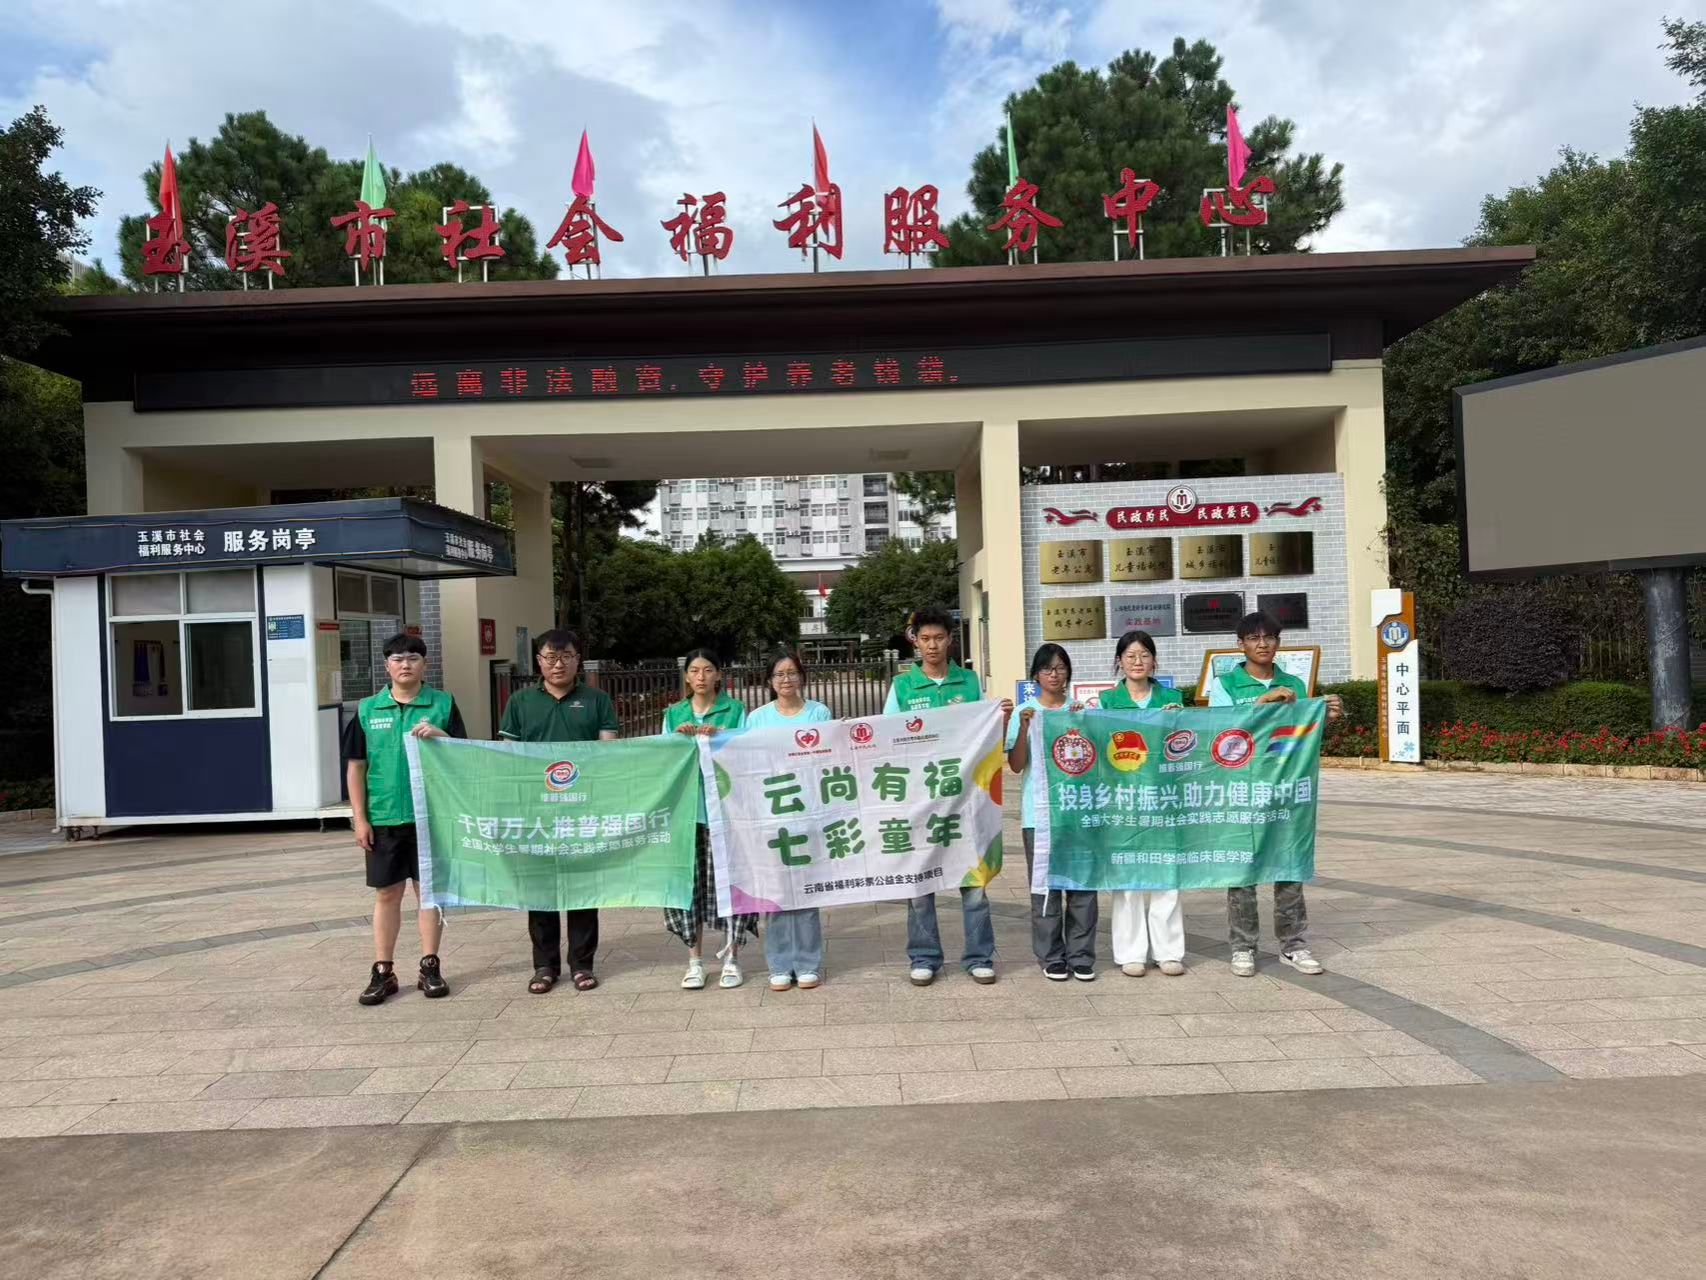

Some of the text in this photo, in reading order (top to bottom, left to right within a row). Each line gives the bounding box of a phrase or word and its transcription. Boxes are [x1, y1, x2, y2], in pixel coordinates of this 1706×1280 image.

[141, 168, 1276, 276] 玉溪市社会福利服务中心
[1116, 509, 1170, 523] 民政为民
[1197, 505, 1251, 520] 民政爱民
[137, 529, 205, 543] 玉溪市社会
[223, 528, 316, 553] 服务岗亭
[138, 543, 206, 557] 福利服务中心
[1396, 662, 1411, 735] 中心平面
[763, 757, 964, 816] 云尚有福
[457, 807, 672, 841] 千团万人推普强国行
[767, 813, 964, 867] 七彩童年
[1110, 851, 1254, 866] 新疆和田学院临床医学院
[803, 867, 944, 894] 云南省福利彩票公益金支持项目
